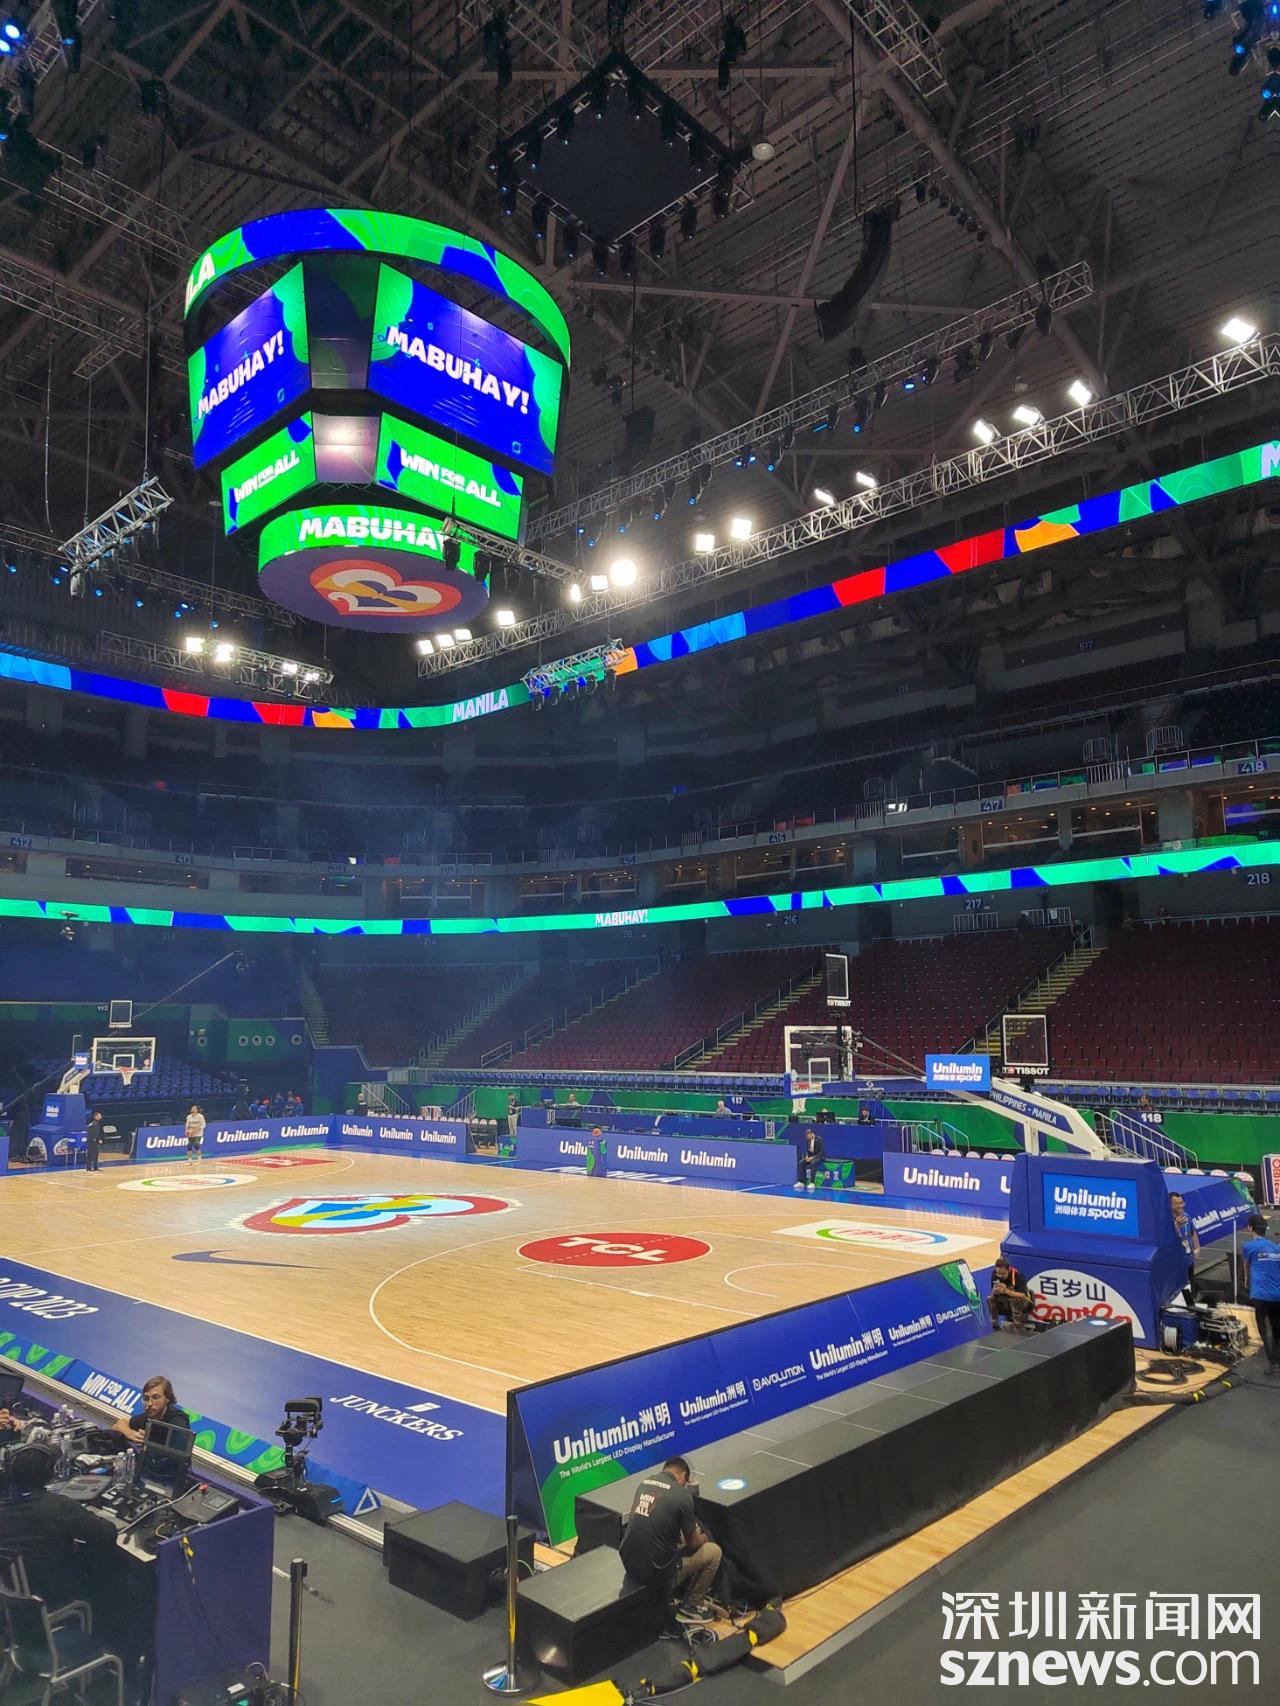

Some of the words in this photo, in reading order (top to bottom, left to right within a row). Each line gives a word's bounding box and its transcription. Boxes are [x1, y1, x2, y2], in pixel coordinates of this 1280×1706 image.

[197, 329, 284, 419] MABUHAY!
[387, 325, 530, 415] MABUHAY!
[234, 476, 259, 504] WIN
[274, 449, 300, 476] ALL
[400, 447, 440, 481] WIN
[440, 467, 466, 486] FOR
[465, 480, 502, 508] ALL
[452, 688, 509, 722] MANILA
[1240, 760, 1264, 774] 418
[983, 800, 1000, 812] 417
[12, 837, 31, 848] 412
[771, 833, 786, 843] 416
[1247, 873, 1270, 885] 218
[965, 899, 982, 910] 217
[595, 909, 648, 926] MABUHAY!
[784, 915, 797, 925] 216
[932, 1061, 983, 1075] Unilumin
[956, 1073, 982, 1084] sports
[1015, 1066, 1050, 1076] TISSOT
[989, 1089, 1028, 1113] PHILIPPINES
[1031, 1105, 1057, 1126] MANILA
[1141, 1112, 1162, 1123] 118
[146, 1134, 204, 1149] Unilum
[216, 1128, 270, 1143] Unilumin
[280, 1124, 329, 1138] Unilumin
[342, 1123, 373, 1137] Unilumin
[380, 1126, 413, 1141] Unilumin
[420, 1130, 457, 1145] Unilumin
[559, 1140, 588, 1155] Unilu
[617, 1145, 668, 1163] Unilumin
[680, 1150, 736, 1169] Unilumin
[903, 1166, 981, 1191] Unilumin
[1054, 1186, 1127, 1210] Unilumin
[1087, 1207, 1126, 1220] sports
[557, 1236, 669, 1262] TCL
[1039, 1276, 1107, 1302] 百岁山
[8, 1295, 99, 1319] 2023
[888, 1319, 921, 1341] Unilumin
[809, 1335, 865, 1370] Unilumin
[862, 1327, 885, 1351] 洲明
[81, 1371, 110, 1398] WIN
[761, 1364, 805, 1388] AVOLUTION
[104, 1380, 123, 1397] FOR
[680, 1389, 728, 1418] Unilumin
[726, 1380, 746, 1400] 洲明
[111, 1388, 141, 1414] ALL
[329, 1394, 465, 1441] JUNCKERS
[553, 1415, 641, 1465] Unilumin
[638, 1402, 672, 1433] 洲明
[559, 1469, 571, 1479] The
[571, 1461, 592, 1475] World's
[592, 1453, 613, 1468] Largest
[612, 1443, 643, 1459] LED-Display
[642, 1430, 675, 1447] Manufacturer
[635, 1505, 650, 1517] ALL
